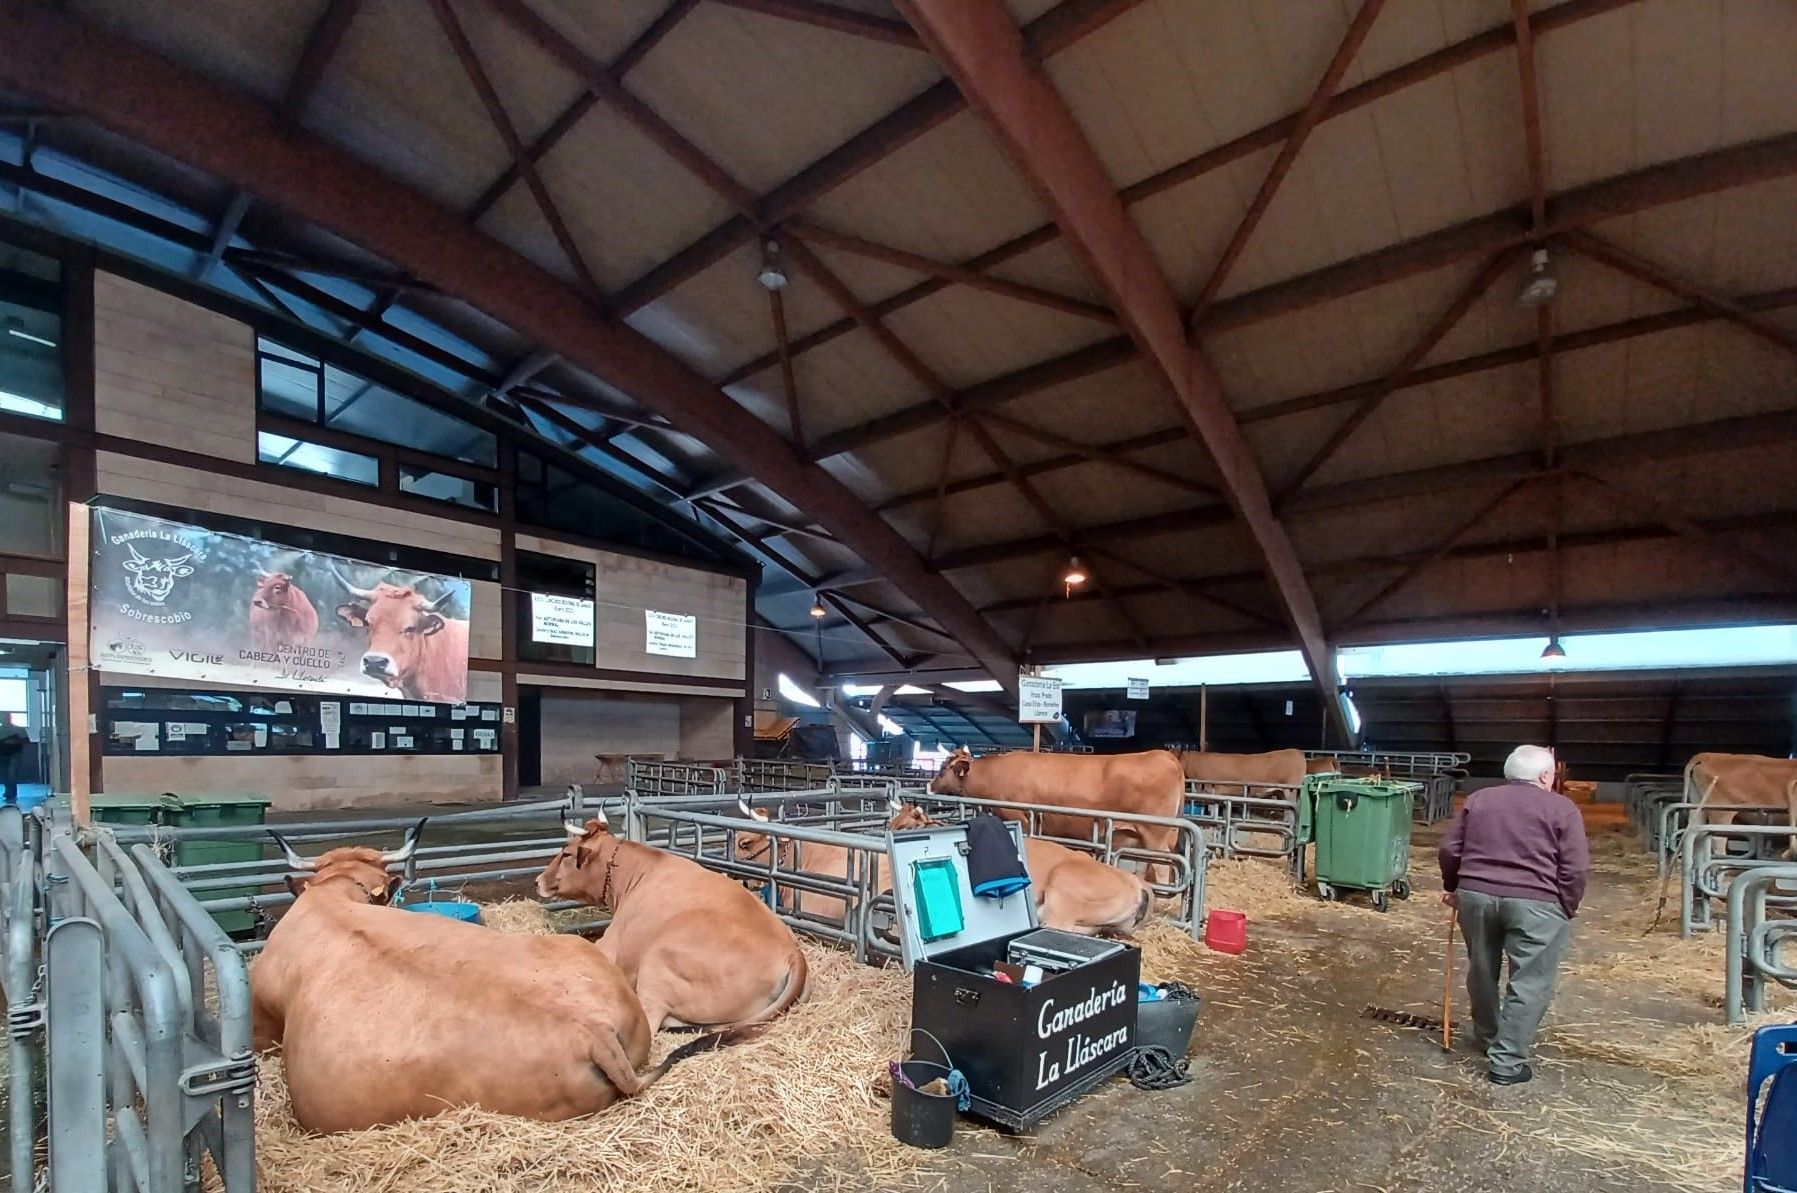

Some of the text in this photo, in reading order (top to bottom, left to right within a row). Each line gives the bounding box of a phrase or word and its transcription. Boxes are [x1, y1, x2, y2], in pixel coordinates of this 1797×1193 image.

[160, 530, 171, 541] La
[120, 603, 192, 625] Sobrescobio
[239, 649, 281, 664] CABEZA
[283, 655, 291, 665] Y
[292, 656, 331, 669] CUELLO
[277, 642, 331, 659] CENTRO DE
[1037, 980, 1127, 1039] Ganadería
[1035, 1026, 1128, 1091] La Lláscara
